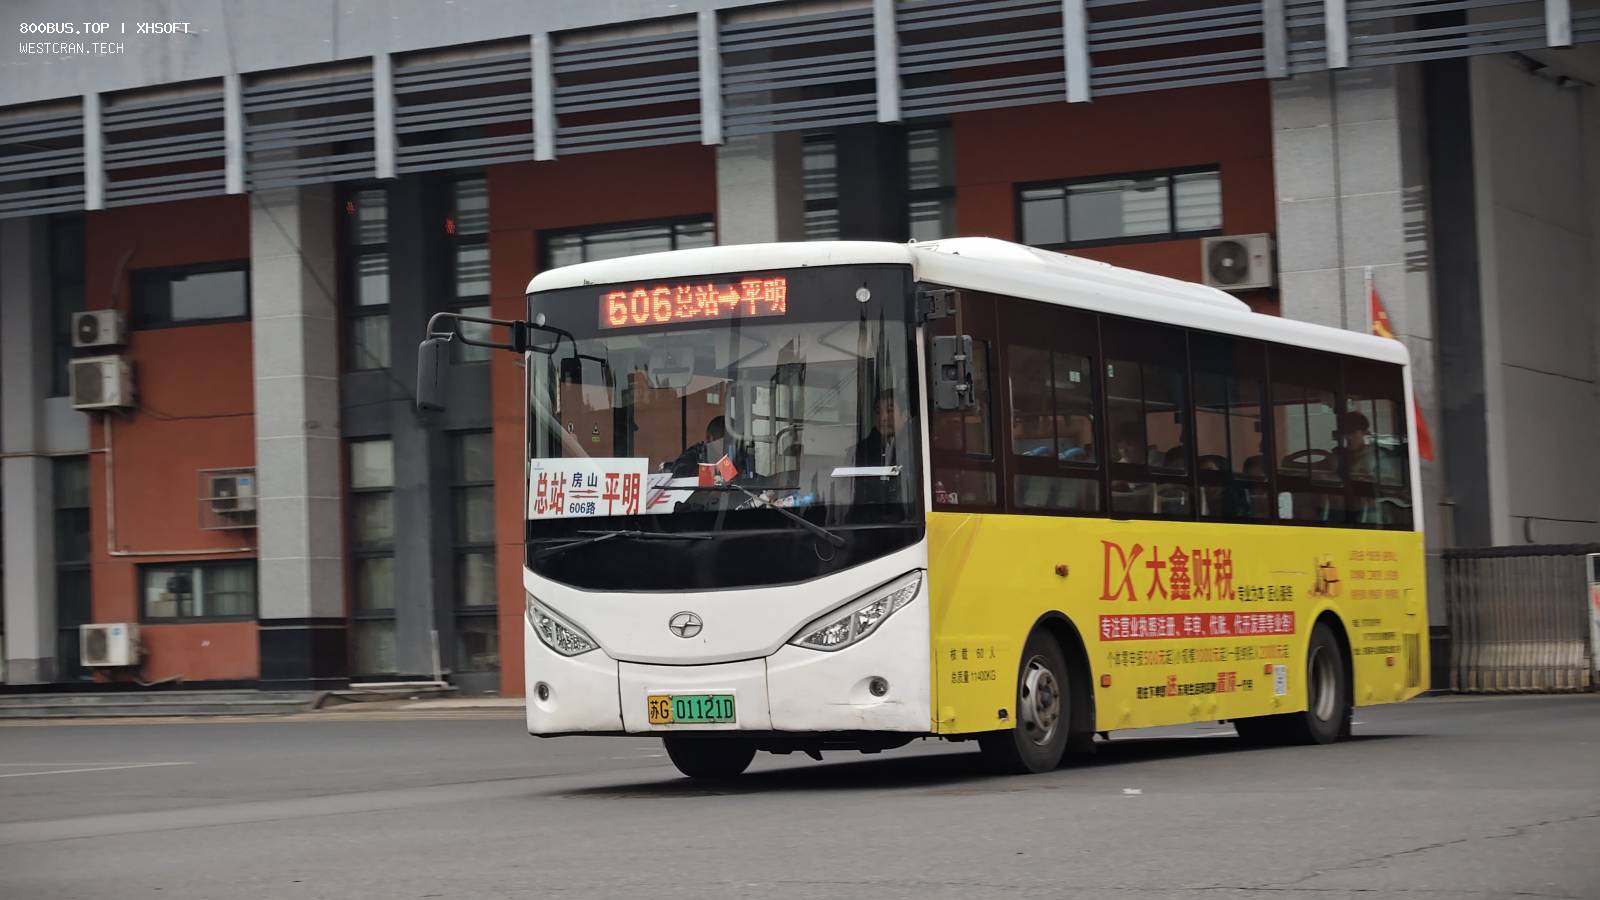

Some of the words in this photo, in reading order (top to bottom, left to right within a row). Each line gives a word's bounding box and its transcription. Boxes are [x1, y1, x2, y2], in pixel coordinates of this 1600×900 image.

[533, 471, 567, 516] 总站
[571, 471, 598, 488] 房山
[602, 472, 641, 516] 平明
[569, 501, 596, 515] 606路
